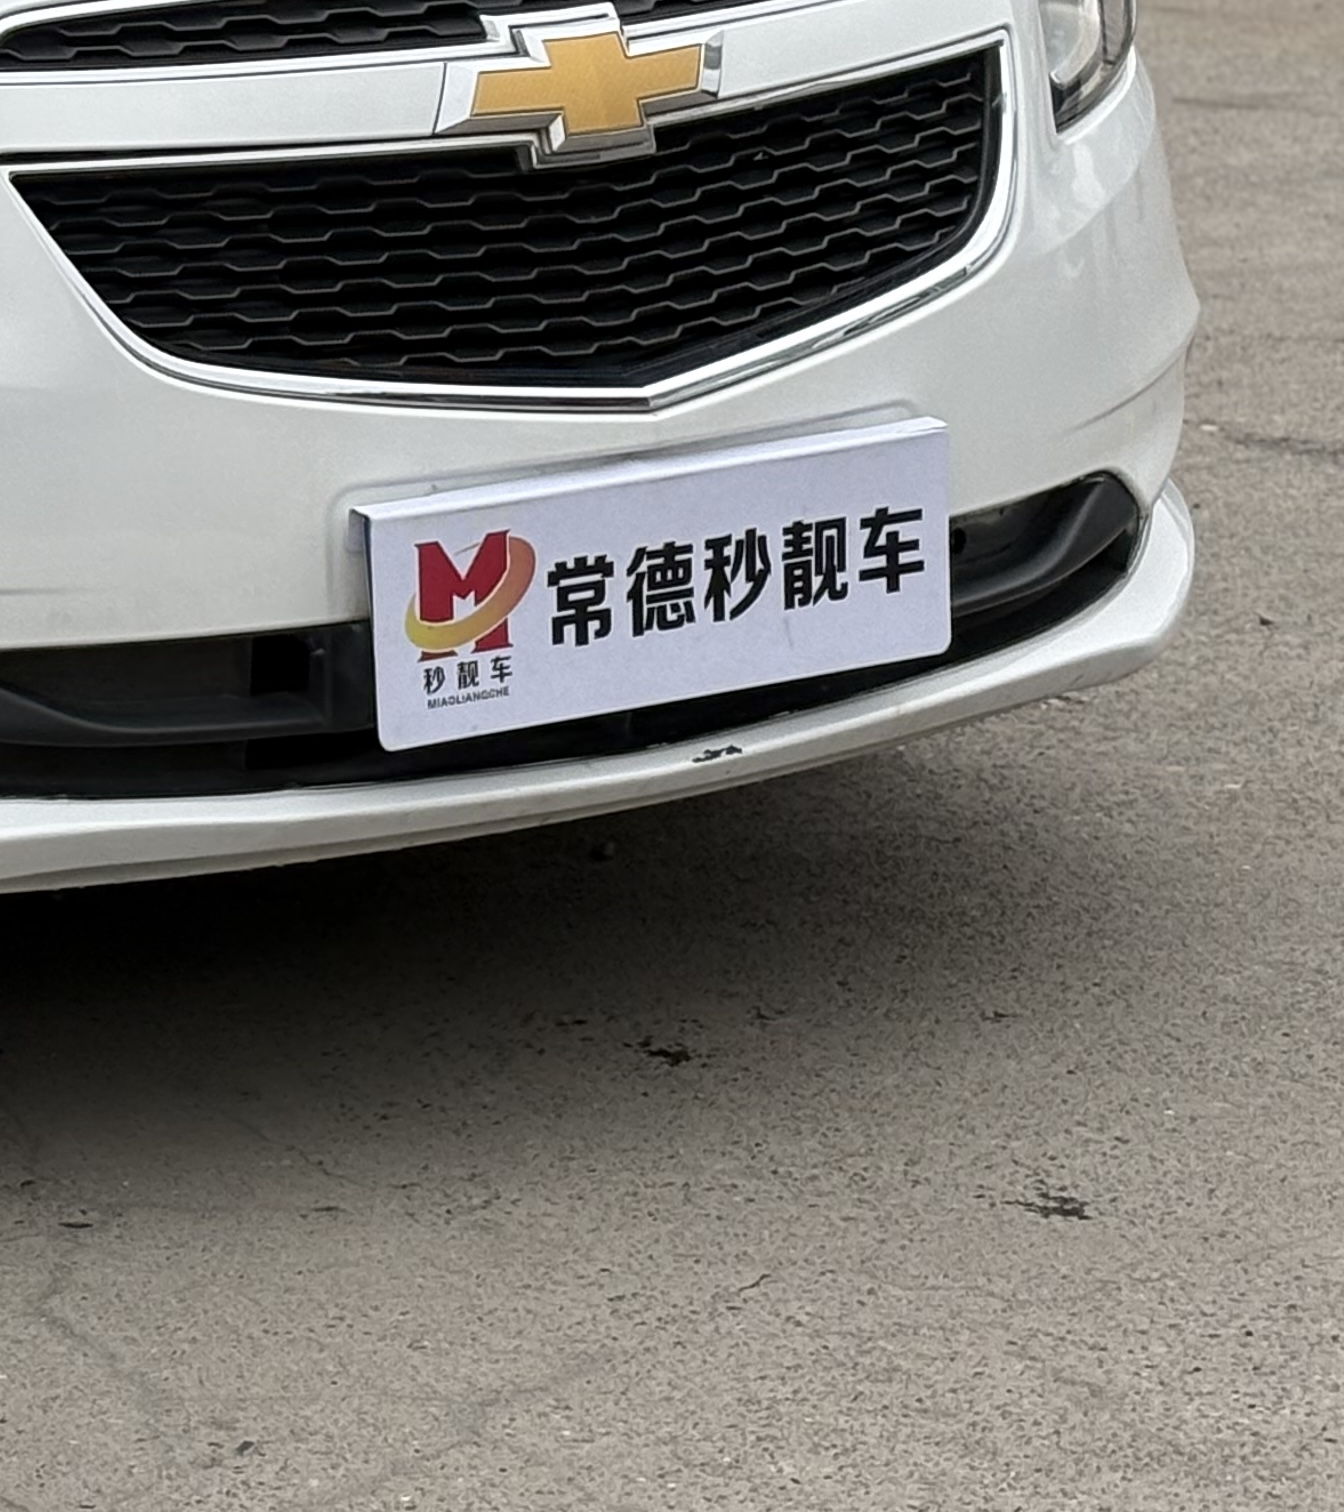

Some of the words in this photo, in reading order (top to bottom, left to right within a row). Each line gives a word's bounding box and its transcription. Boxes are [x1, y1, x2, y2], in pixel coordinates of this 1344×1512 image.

[546, 506, 926, 646] 常德秒靓车
[422, 655, 513, 695] 秒靓车
